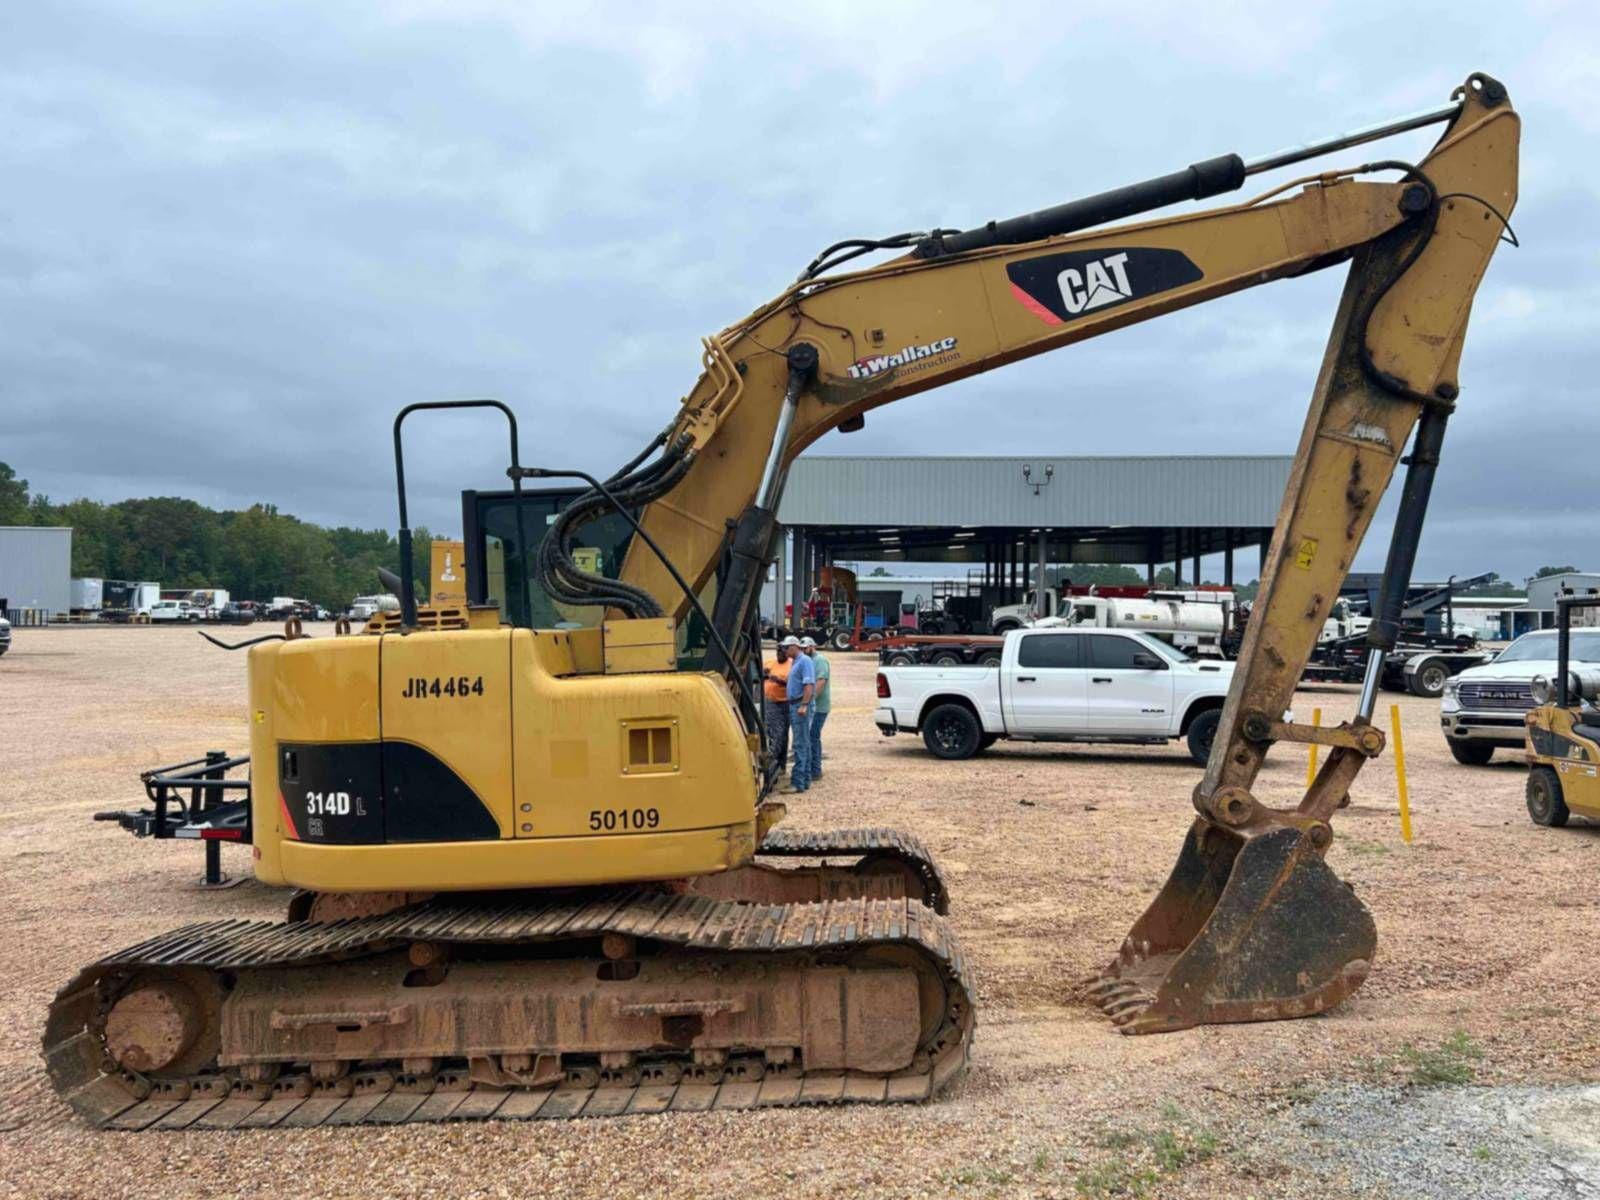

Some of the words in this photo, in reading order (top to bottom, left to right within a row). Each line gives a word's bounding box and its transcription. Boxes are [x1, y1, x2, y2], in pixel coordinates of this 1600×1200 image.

[1057, 252, 1133, 313] CAT
[402, 676, 483, 698] JR4464
[306, 791, 350, 815] 314D
[356, 797, 367, 816] L
[589, 808, 660, 830] 50109
